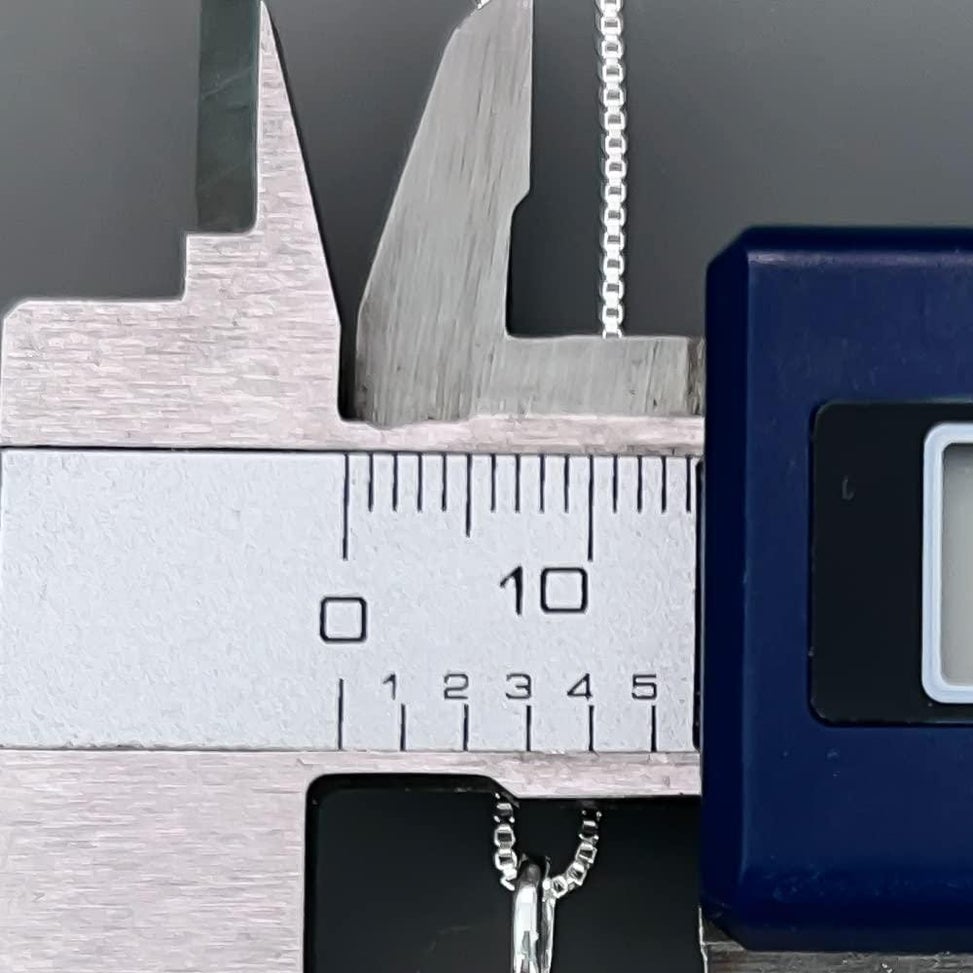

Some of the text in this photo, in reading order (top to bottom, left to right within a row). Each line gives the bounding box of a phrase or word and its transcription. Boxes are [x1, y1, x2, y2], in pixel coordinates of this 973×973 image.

[499, 565, 589, 614] 10
[382, 673, 658, 701] 1 2 3 4 5
